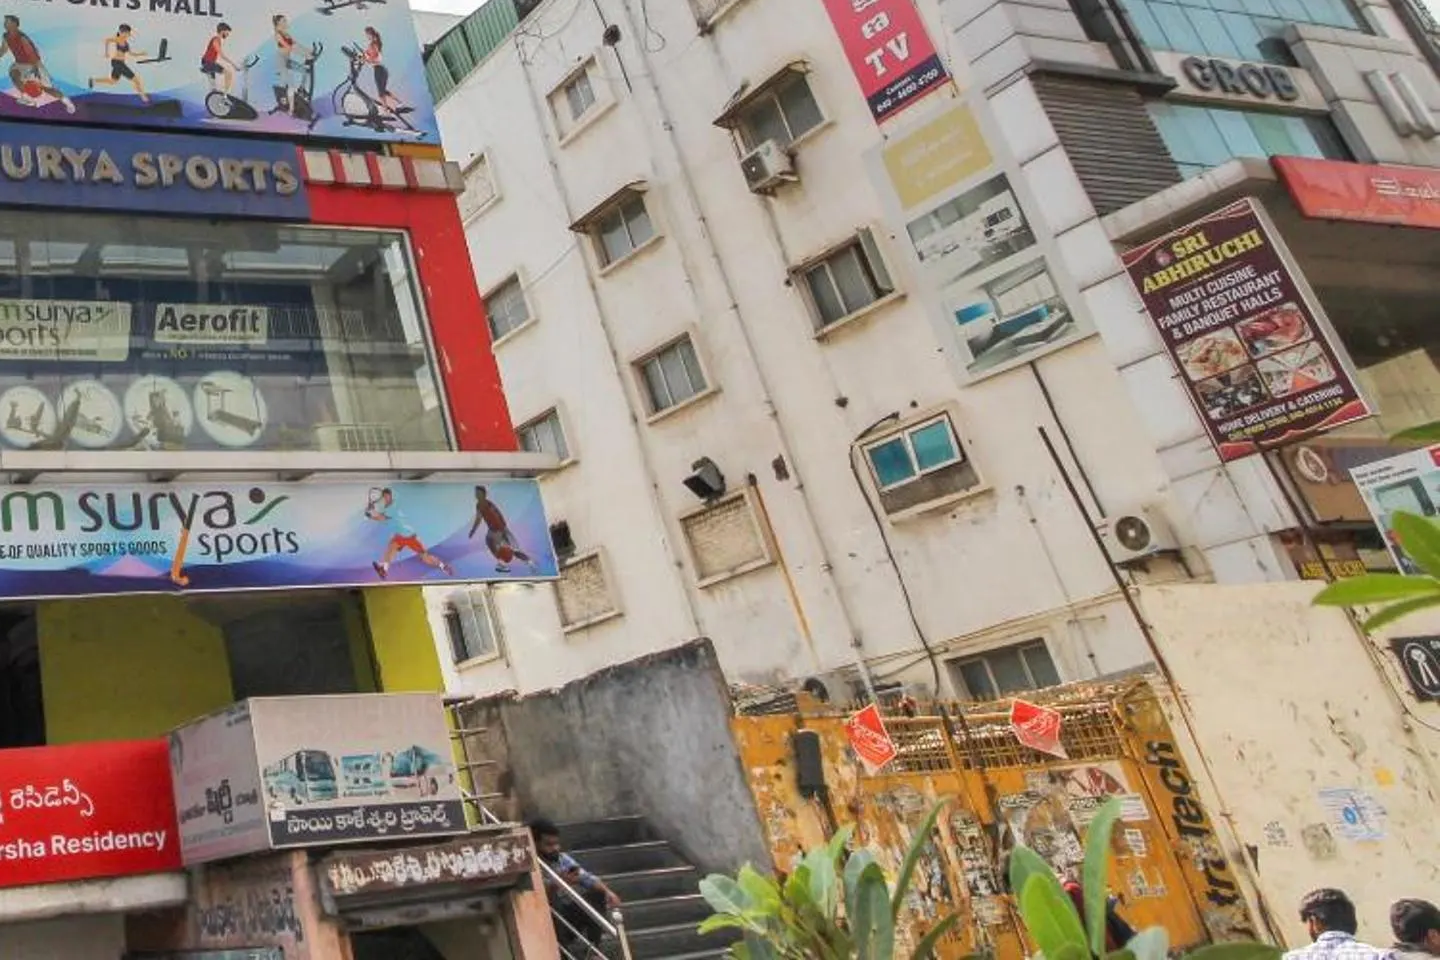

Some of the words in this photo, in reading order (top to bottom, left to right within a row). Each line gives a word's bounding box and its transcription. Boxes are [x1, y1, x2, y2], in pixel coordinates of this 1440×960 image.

[864, 32, 910, 78] TV
[131, 151, 300, 196] SPORTS
[1142, 228, 1264, 295] ABHIRUCHI
[1171, 231, 1210, 259] SRI
[1157, 302, 1201, 329] FAMILY
[1201, 270, 1283, 311] RESTAURANT
[1168, 286, 1207, 310] MULTI
[1207, 264, 1258, 293] CUISINE
[157, 306, 260, 334] Aerofit
[1183, 304, 1240, 336] BANQUET
[1240, 286, 1284, 315] HALLS
[26, 543, 77, 560] QUALITY
[80, 541, 126, 558] SPORTS
[128, 540, 168, 556] GOODS
[197, 526, 300, 563] sports
[51, 829, 167, 856] Residency
